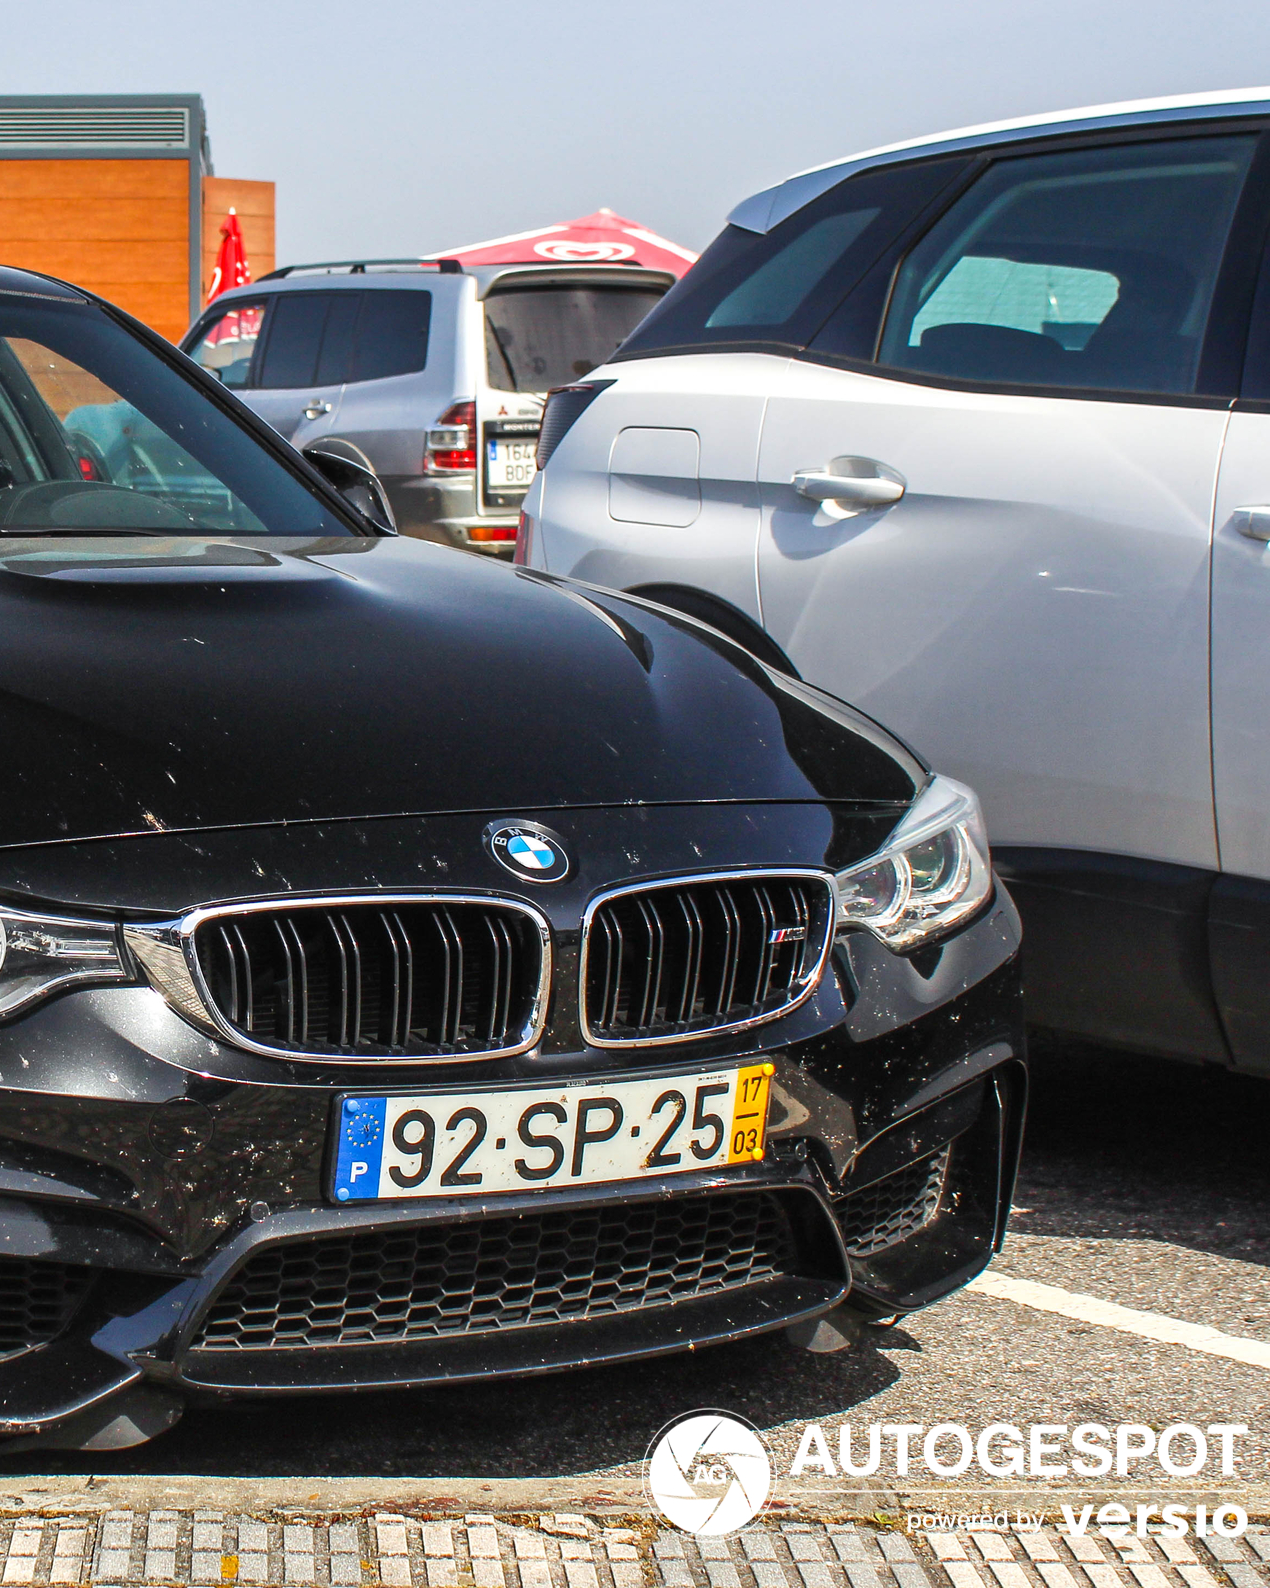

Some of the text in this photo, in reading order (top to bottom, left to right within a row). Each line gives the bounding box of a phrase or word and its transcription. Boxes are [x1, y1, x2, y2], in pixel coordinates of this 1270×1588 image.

[503, 423, 541, 431] MONTER
[505, 444, 536, 461] 164
[505, 464, 534, 482] BDF
[494, 827, 549, 847] BMW
[742, 1075, 763, 1103] 17
[733, 1127, 758, 1155] 03
[349, 1160, 369, 1184] P
